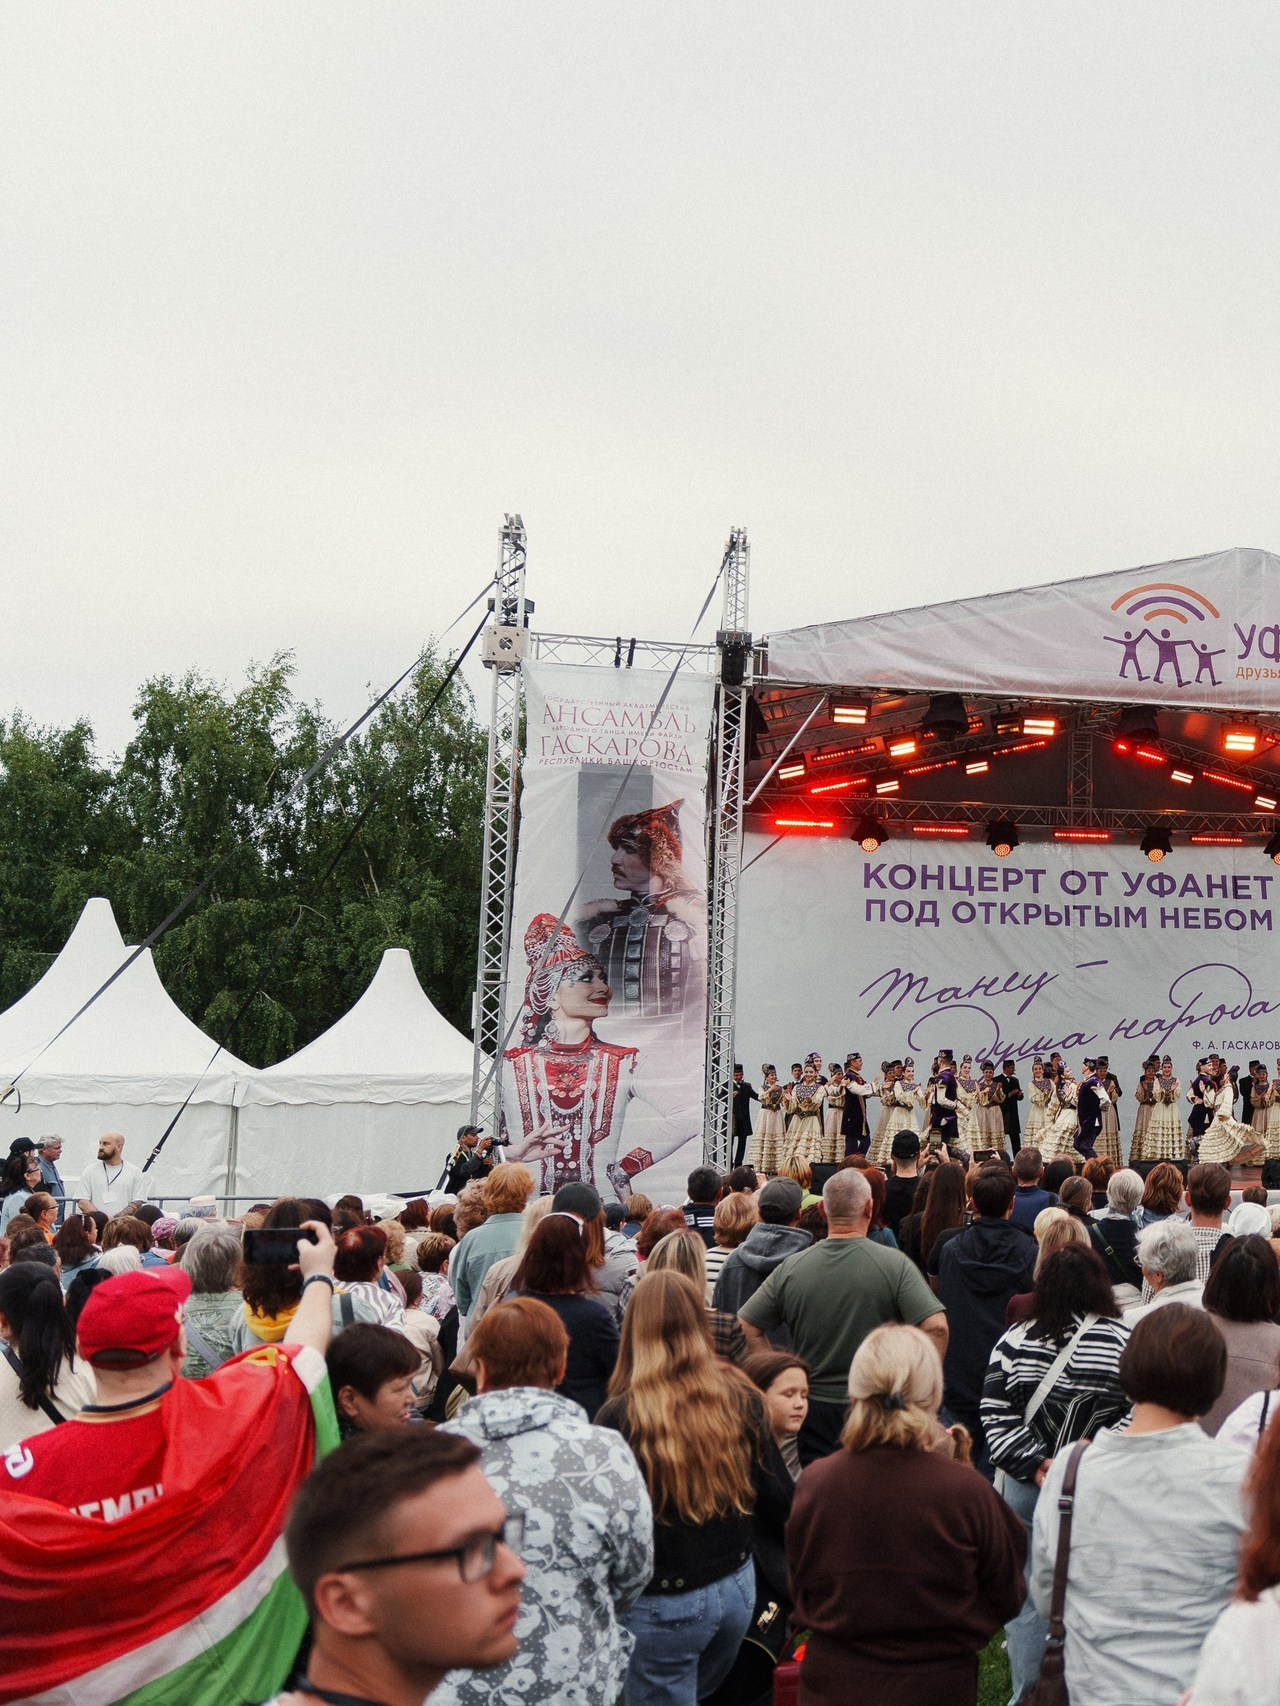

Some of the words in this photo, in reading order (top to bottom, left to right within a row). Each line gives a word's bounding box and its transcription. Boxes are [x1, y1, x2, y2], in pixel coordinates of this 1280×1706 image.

[543, 703, 696, 734] АНСАМБЛЬ
[629, 730, 655, 738] ИМЕИ
[538, 756, 603, 766] РЕСПУБЛИКИ
[608, 758, 693, 774] БАШКОРТОСТАН
[541, 734, 692, 766] ГАСКАРОВА
[863, 863, 1047, 897] КОНЦЕРТ
[1060, 869, 1109, 897] ОТ
[1120, 871, 1274, 901] УФАНЕТ
[865, 899, 941, 928] ПОД
[951, 901, 1148, 929] ОТКРЫТЫМ
[1160, 906, 1273, 932] НЕБОМ
[1192, 1040, 1204, 1050] Ф.
[1207, 1040, 1219, 1050] А.
[1222, 1040, 1280, 1051] ГАСКАРОВ
